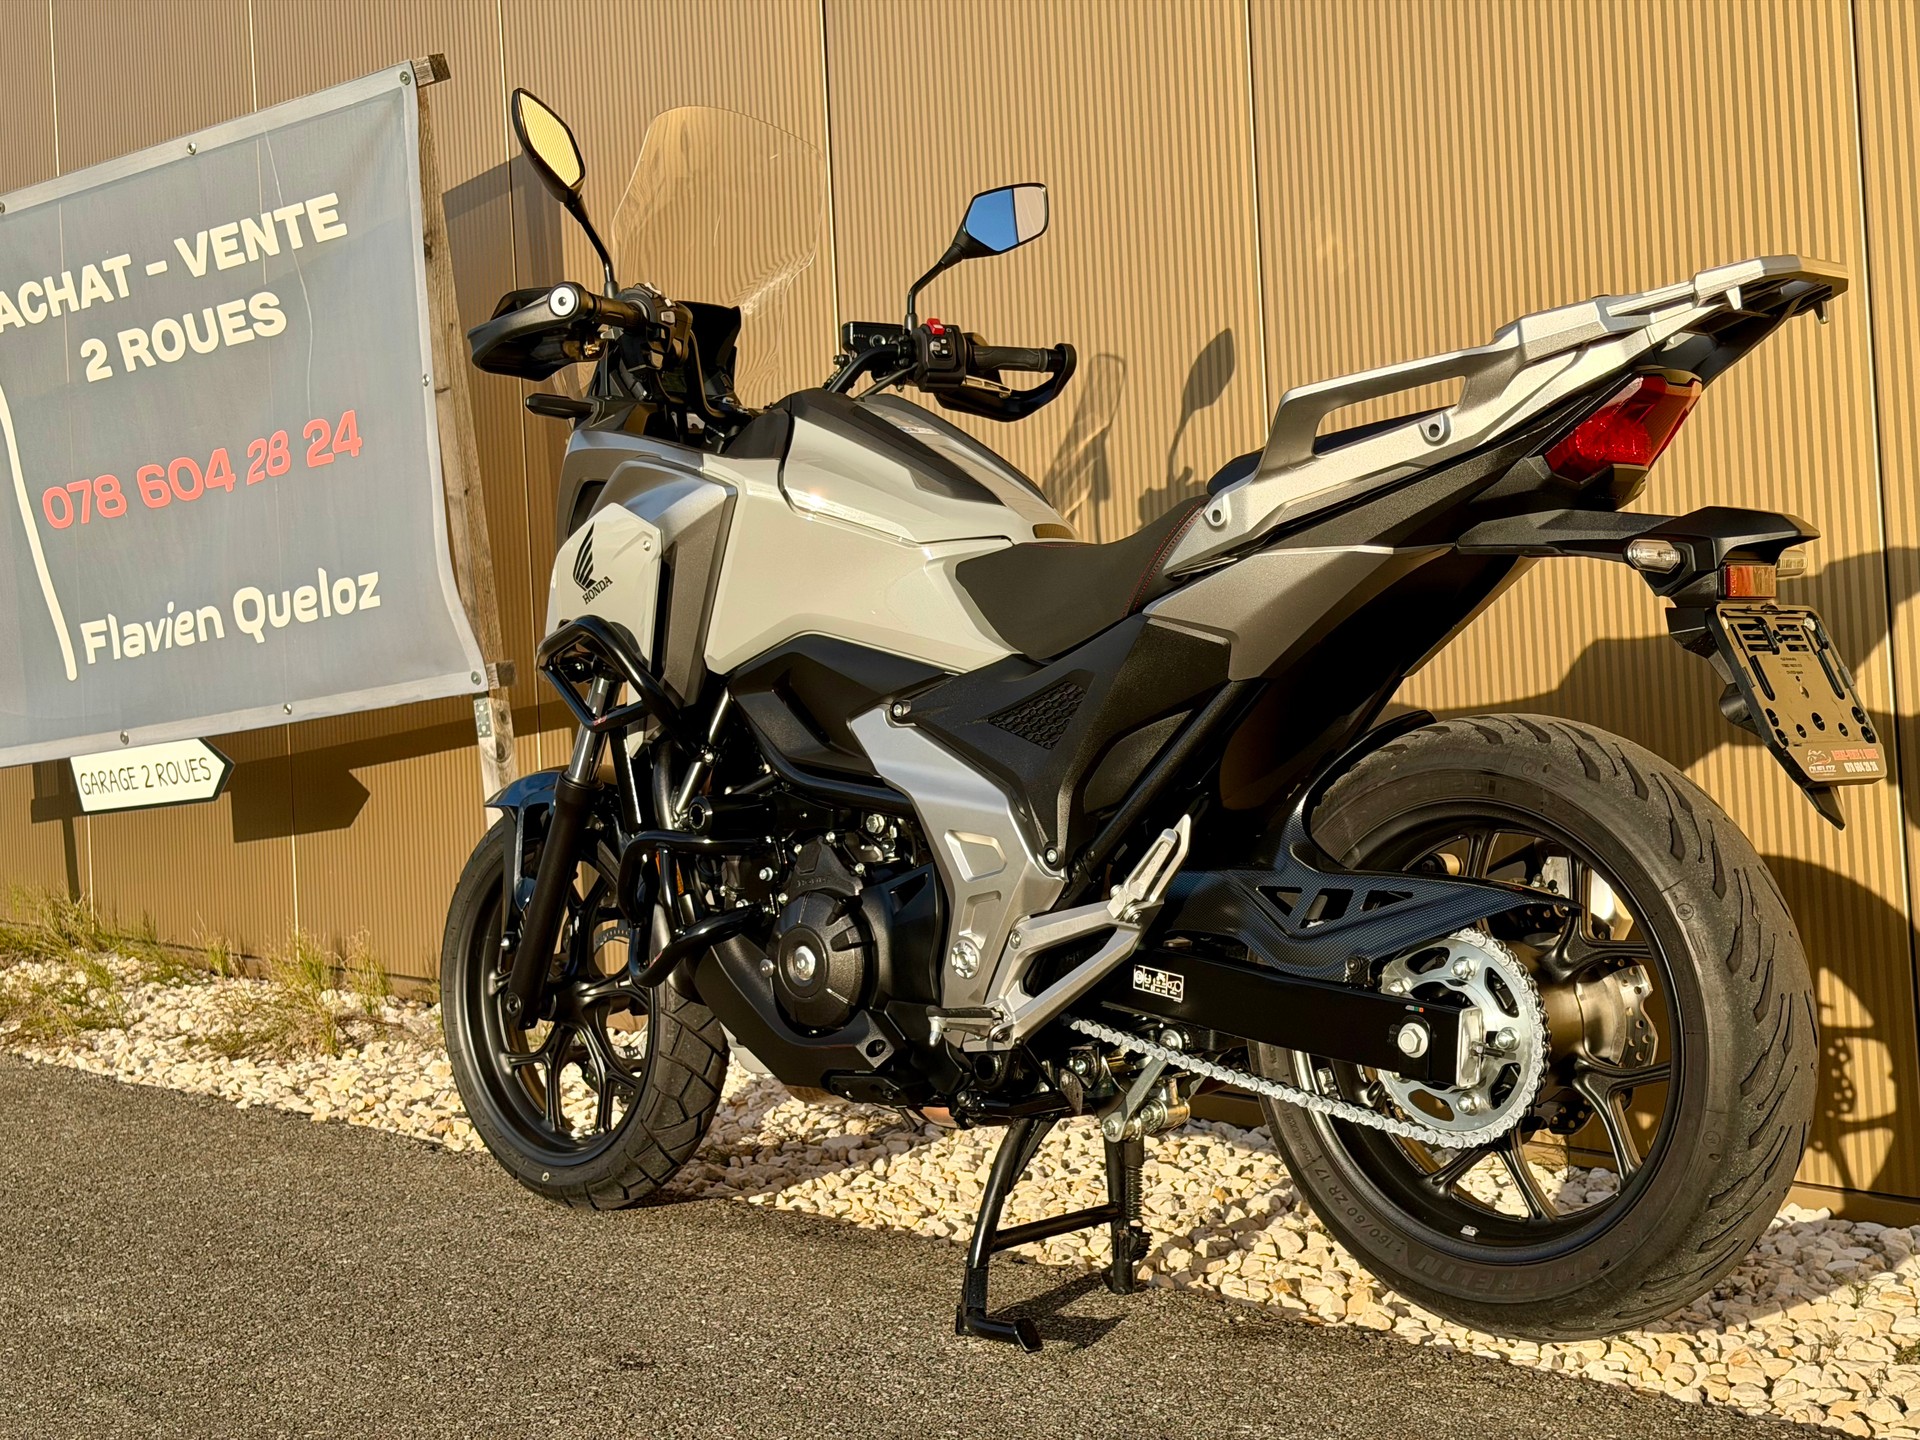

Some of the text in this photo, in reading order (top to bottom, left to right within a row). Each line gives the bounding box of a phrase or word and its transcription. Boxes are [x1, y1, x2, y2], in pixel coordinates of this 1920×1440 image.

[0, 192, 348, 334] ACHAT - VENTE
[80, 291, 288, 382] 2 ROUES
[42, 409, 363, 529] 078 604 28 24
[80, 567, 381, 664] Flavien Queloz
[582, 576, 613, 605] HONDA
[80, 757, 212, 796] GARAGE 2 ROUES
[1314, 1168, 1330, 1182] 17
[1328, 1185, 1348, 1205] ZR
